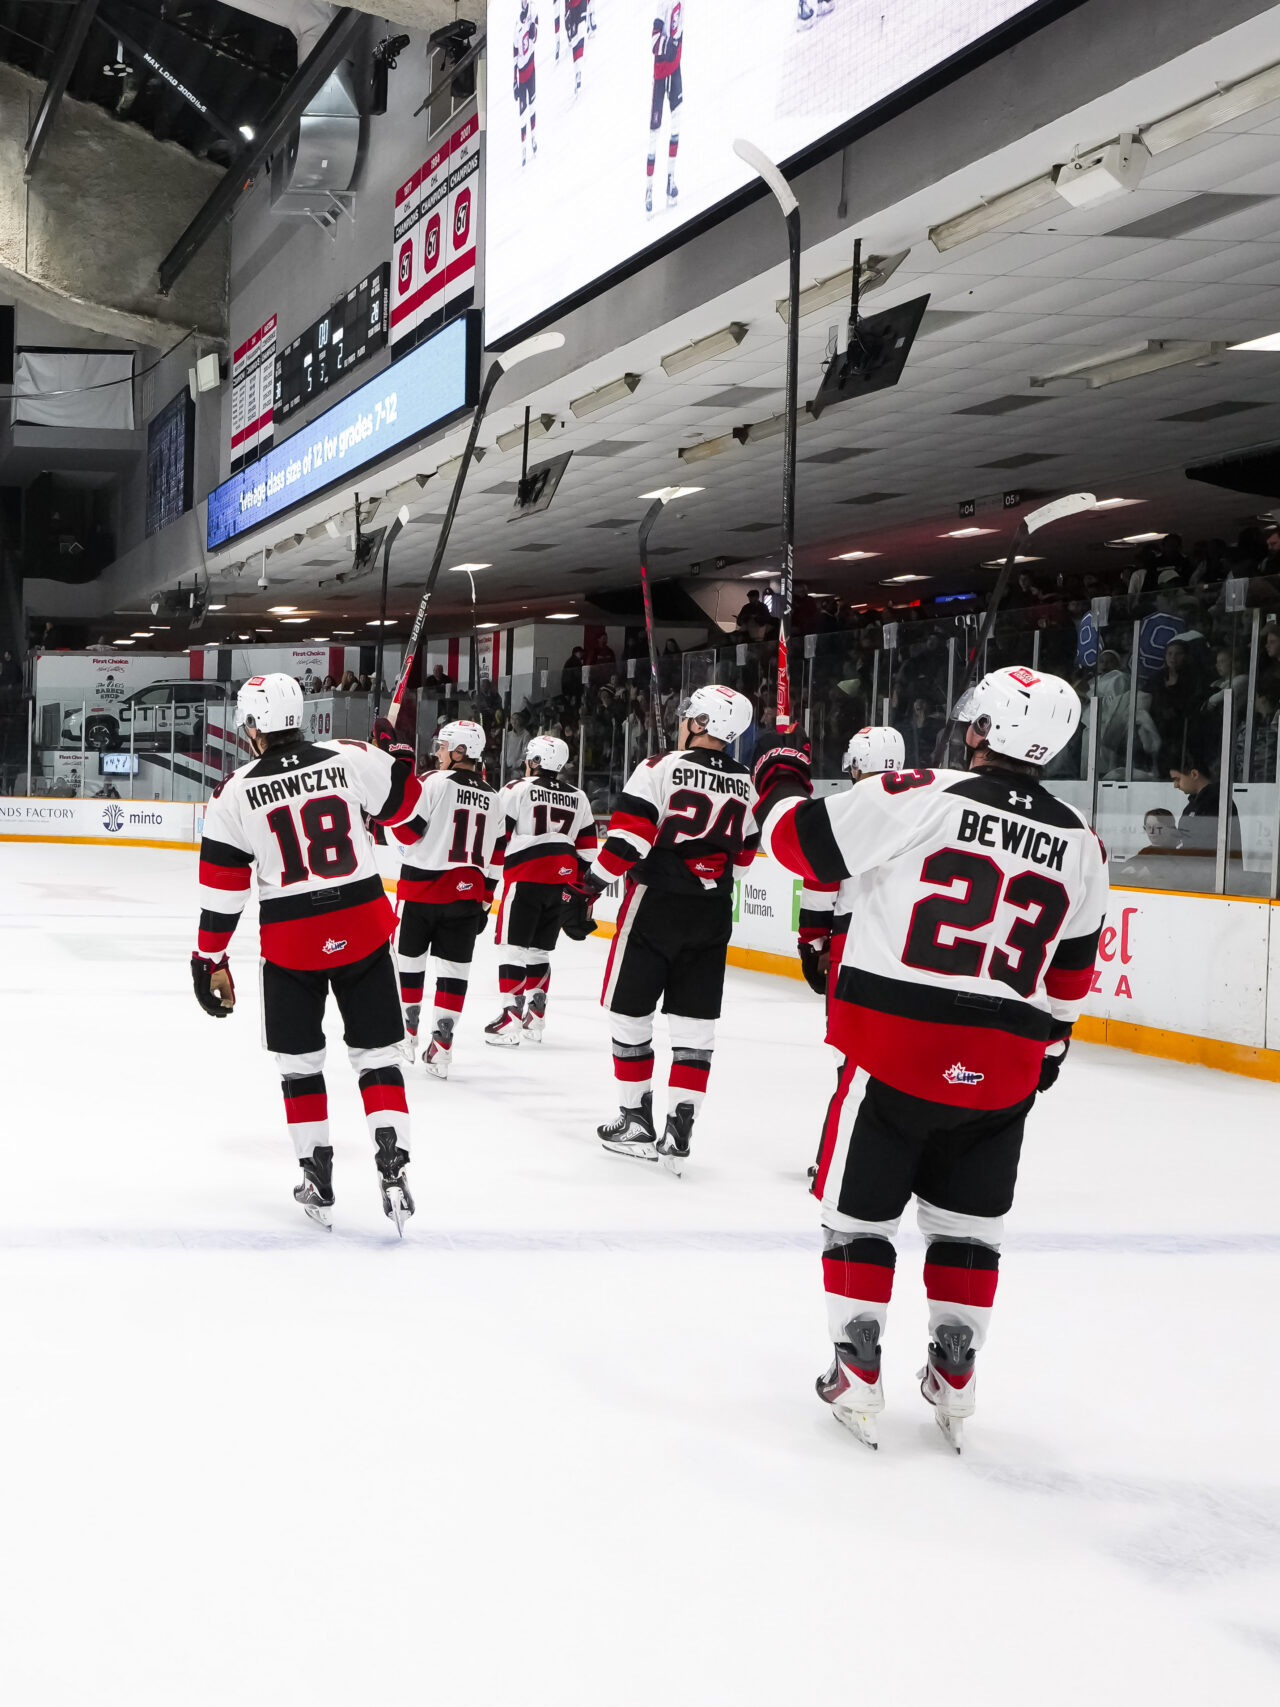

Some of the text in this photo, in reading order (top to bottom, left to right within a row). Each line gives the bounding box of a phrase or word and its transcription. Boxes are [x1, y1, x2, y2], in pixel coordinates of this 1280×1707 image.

[143, 53, 160, 70] MAX
[158, 67, 178, 86] LOAD
[450, 155, 478, 187] CHAMPIONS
[421, 183, 447, 213] CHAMPIONS
[395, 209, 419, 238] CHAMPIONS
[456, 203, 468, 235] 67
[337, 342, 343, 369] 2
[267, 467, 284, 494] class
[286, 456, 301, 482] size
[303, 449, 312, 472] of
[313, 443, 322, 466] 12
[323, 433, 336, 460] for
[339, 409, 372, 455] grades
[375, 392, 397, 428] 7-12
[411, 600, 427, 641] BAUER
[285, 715, 295, 726] 18
[884, 759, 895, 769] 13
[1025, 744, 1048, 761] 23
[245, 766, 349, 810] KRAWCZYK
[456, 788, 490, 811] HAYES
[530, 789, 579, 810] CHITARONI
[672, 767, 751, 801] SPITZNAGE
[26, 807, 76, 819] FACTORY
[129, 811, 163, 825] minto
[533, 804, 576, 836] 17
[653, 788, 747, 850] 24
[266, 794, 359, 887] 18
[448, 808, 487, 869] 11
[956, 809, 1069, 872] BEWICK
[744, 884, 767, 901] More
[743, 900, 774, 918] human.
[901, 846, 1071, 998] 23
